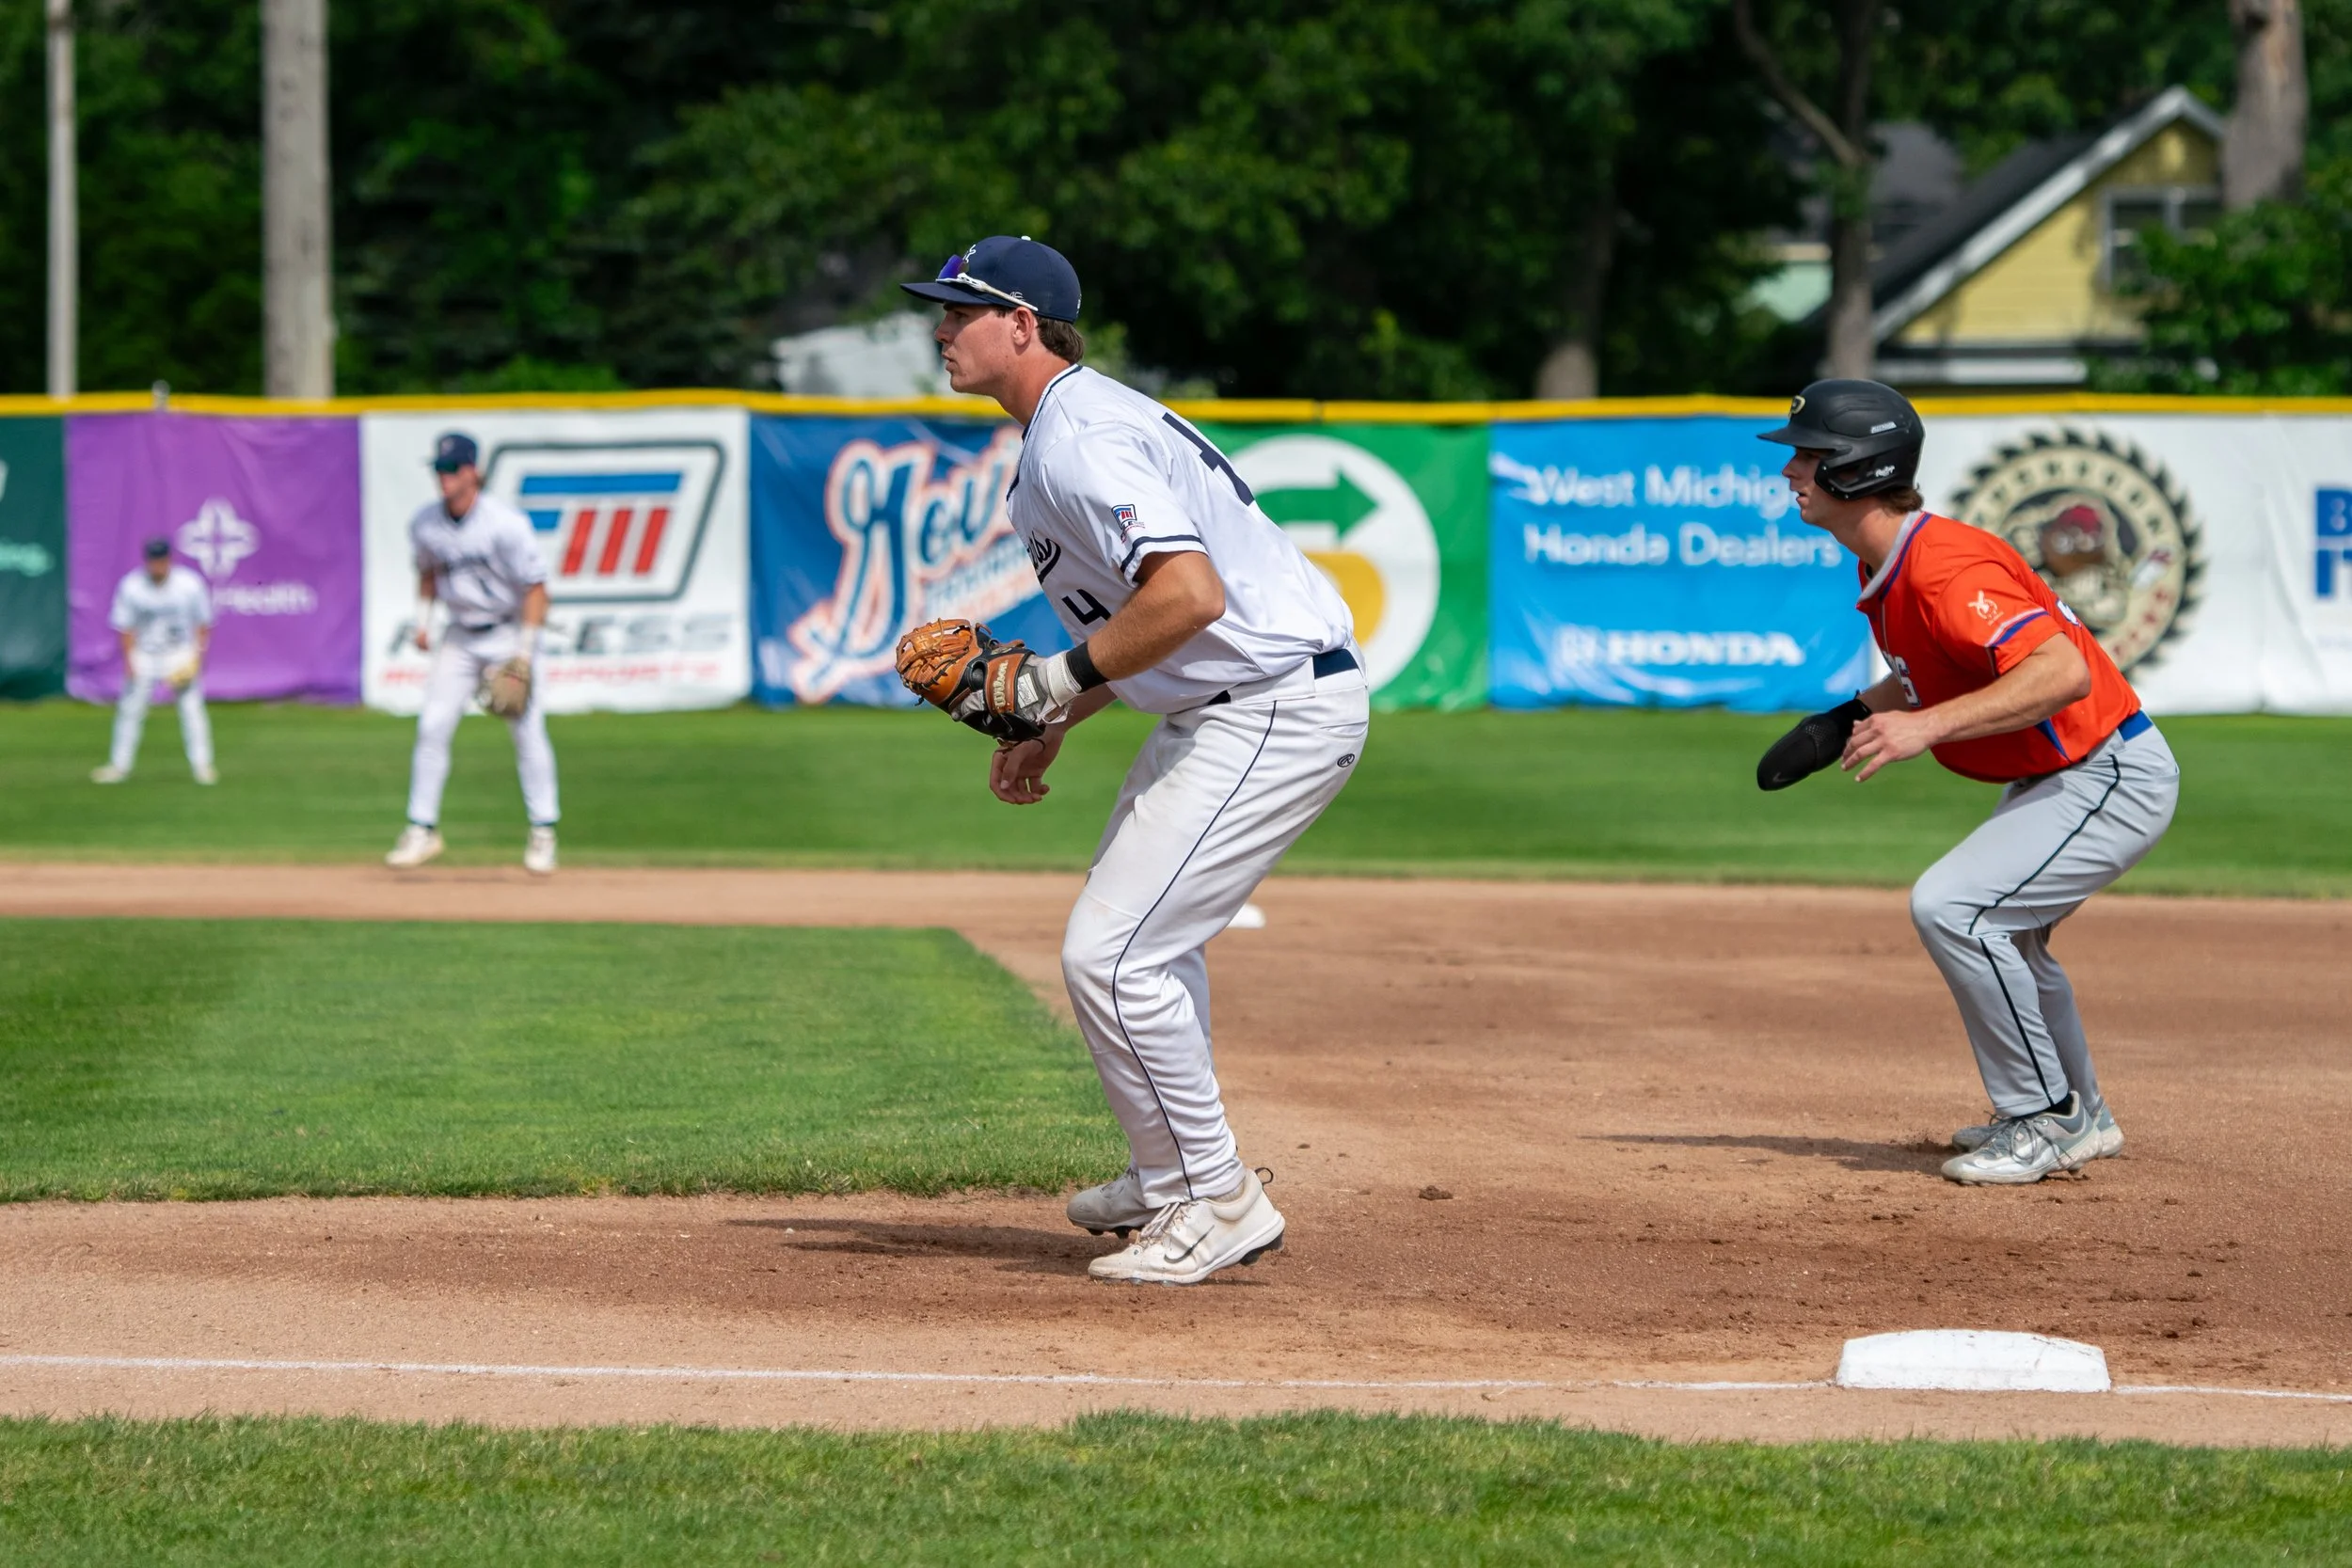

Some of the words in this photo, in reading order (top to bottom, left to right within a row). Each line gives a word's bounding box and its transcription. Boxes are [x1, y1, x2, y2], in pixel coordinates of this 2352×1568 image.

[1526, 465, 1637, 506] West
[1644, 464, 1799, 520] Michig
[1522, 523, 1669, 565] Honda
[1678, 522, 1843, 567] Dealers
[1061, 589, 1112, 626] 4
[1605, 629, 1806, 667] HONDA
[993, 659, 1009, 708] Wilson
